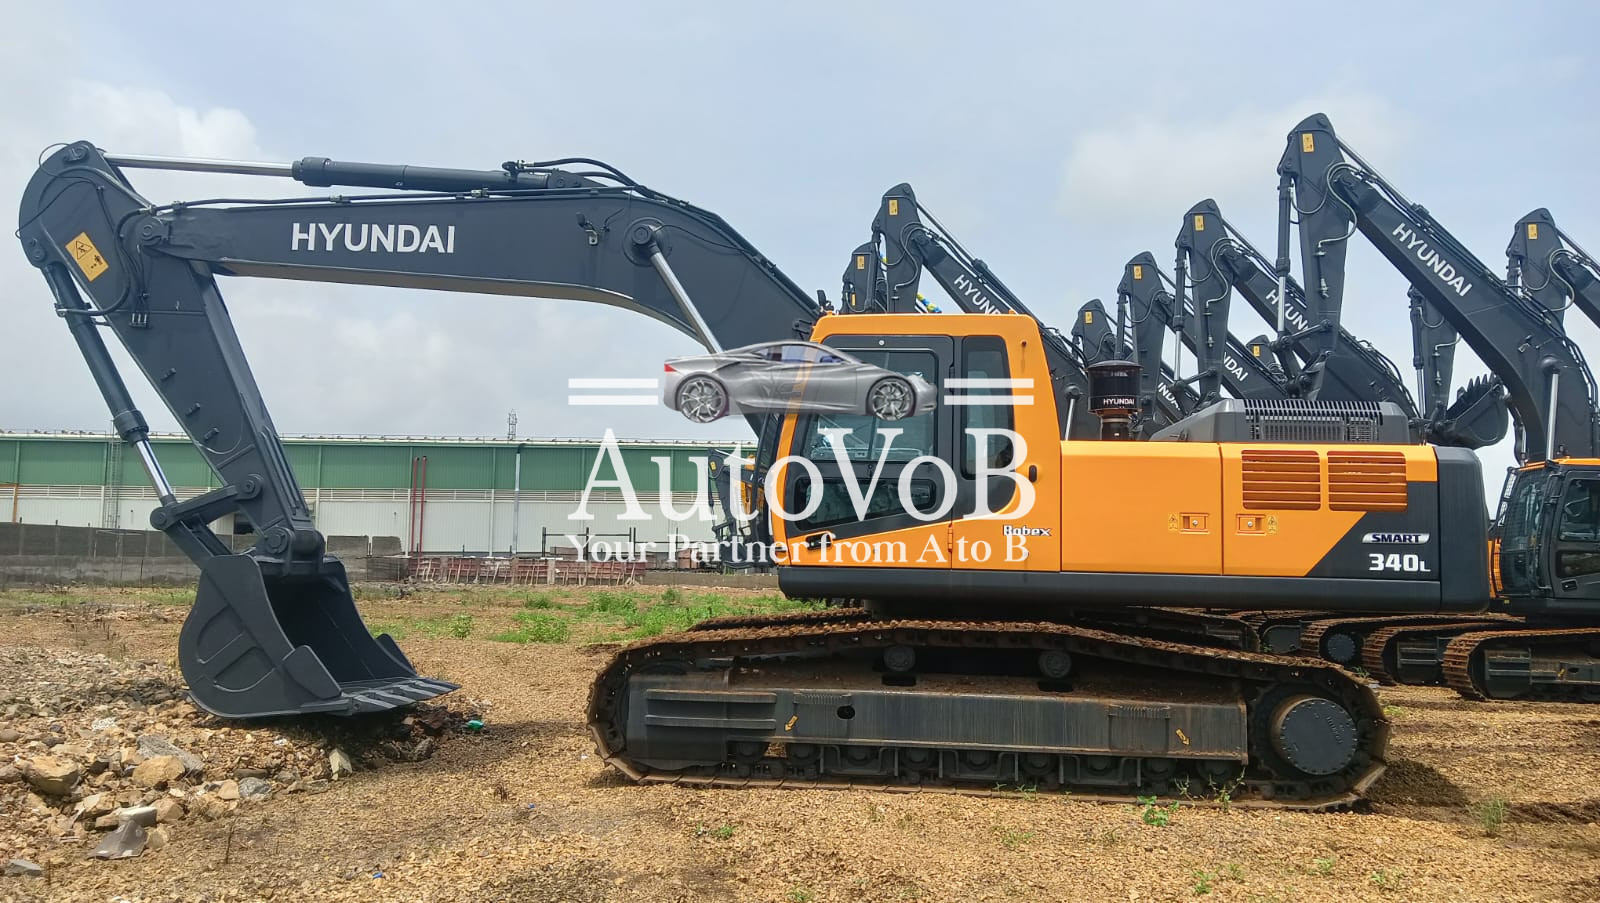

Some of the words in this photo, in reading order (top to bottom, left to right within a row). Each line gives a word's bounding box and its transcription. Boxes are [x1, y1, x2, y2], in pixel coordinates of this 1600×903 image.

[291, 222, 456, 254] HYUNDAI
[1392, 222, 1473, 297] HYUNDAI
[1265, 289, 1309, 330] HUN
[1103, 398, 1135, 406] HYUNDAI
[1372, 534, 1421, 543] SMART
[1368, 553, 1431, 572] 340L
